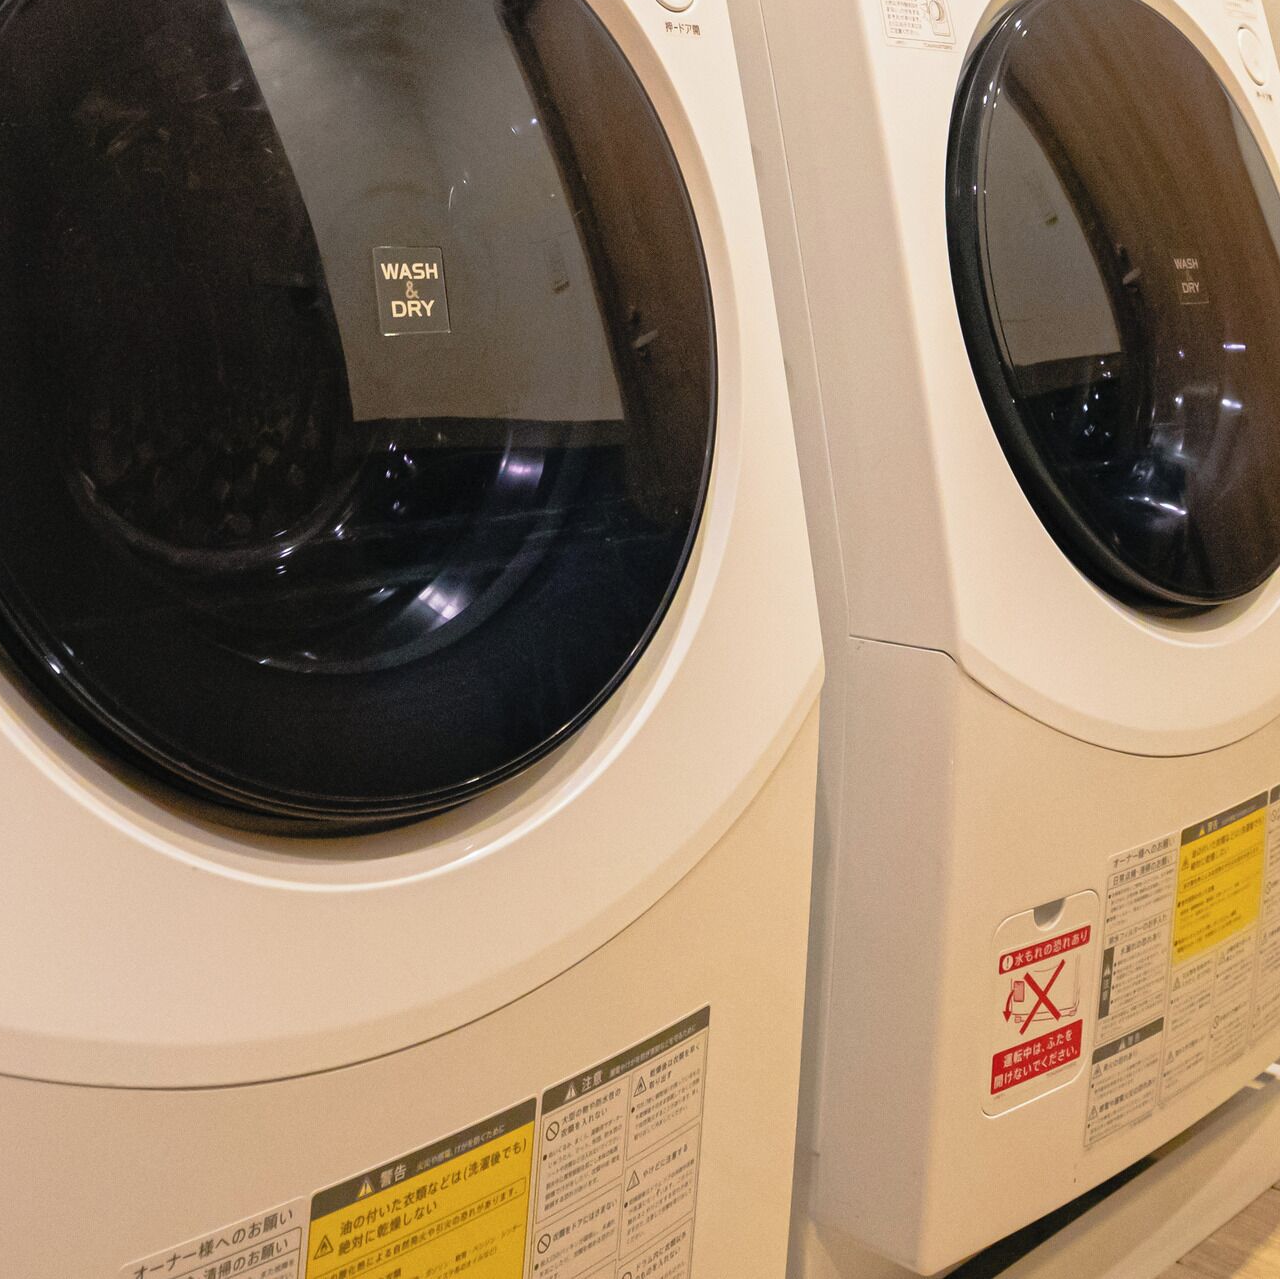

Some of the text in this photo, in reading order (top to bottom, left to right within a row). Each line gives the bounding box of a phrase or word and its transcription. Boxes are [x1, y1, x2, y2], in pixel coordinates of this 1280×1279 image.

[380, 263, 439, 280] WASH
[1173, 257, 1199, 270] WASH
[405, 281, 420, 299] &
[1181, 282, 1200, 294] DRY
[391, 300, 435, 318] DRY
[1014, 929, 1087, 966] 水もれの恐れあり
[1002, 1025, 1073, 1070] 運転中は、ふたを
[993, 1038, 1078, 1093] 開けないでください。
[581, 1070, 602, 1091] 注意
[379, 1163, 407, 1189] 警告
[337, 1201, 437, 1257] 絶対に乾燥しない
[133, 1209, 293, 1279] オーナー様へのお願い
